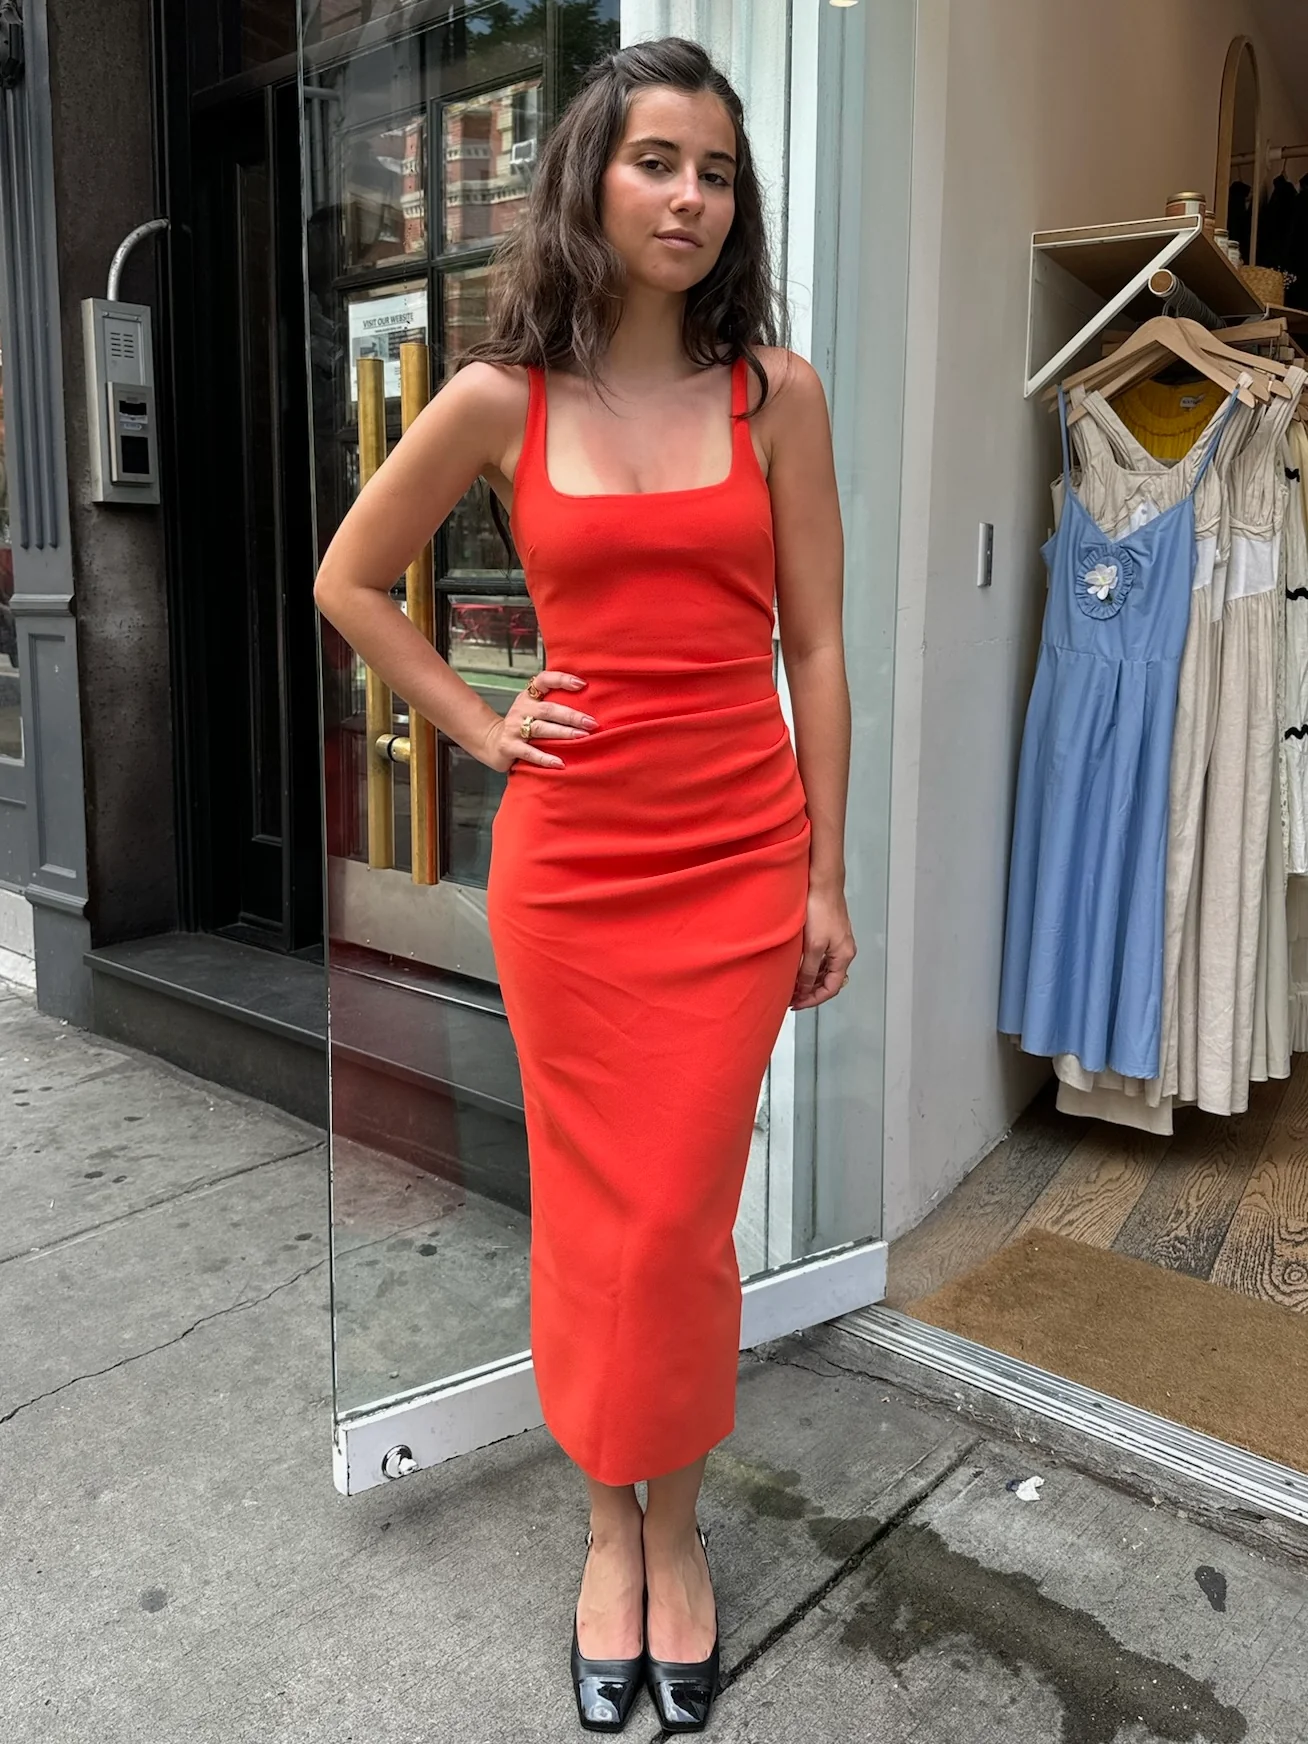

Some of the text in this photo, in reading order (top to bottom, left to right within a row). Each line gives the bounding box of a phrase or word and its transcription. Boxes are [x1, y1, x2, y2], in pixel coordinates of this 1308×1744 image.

[363, 312, 414, 328] VISIT OUR WEBSITE
